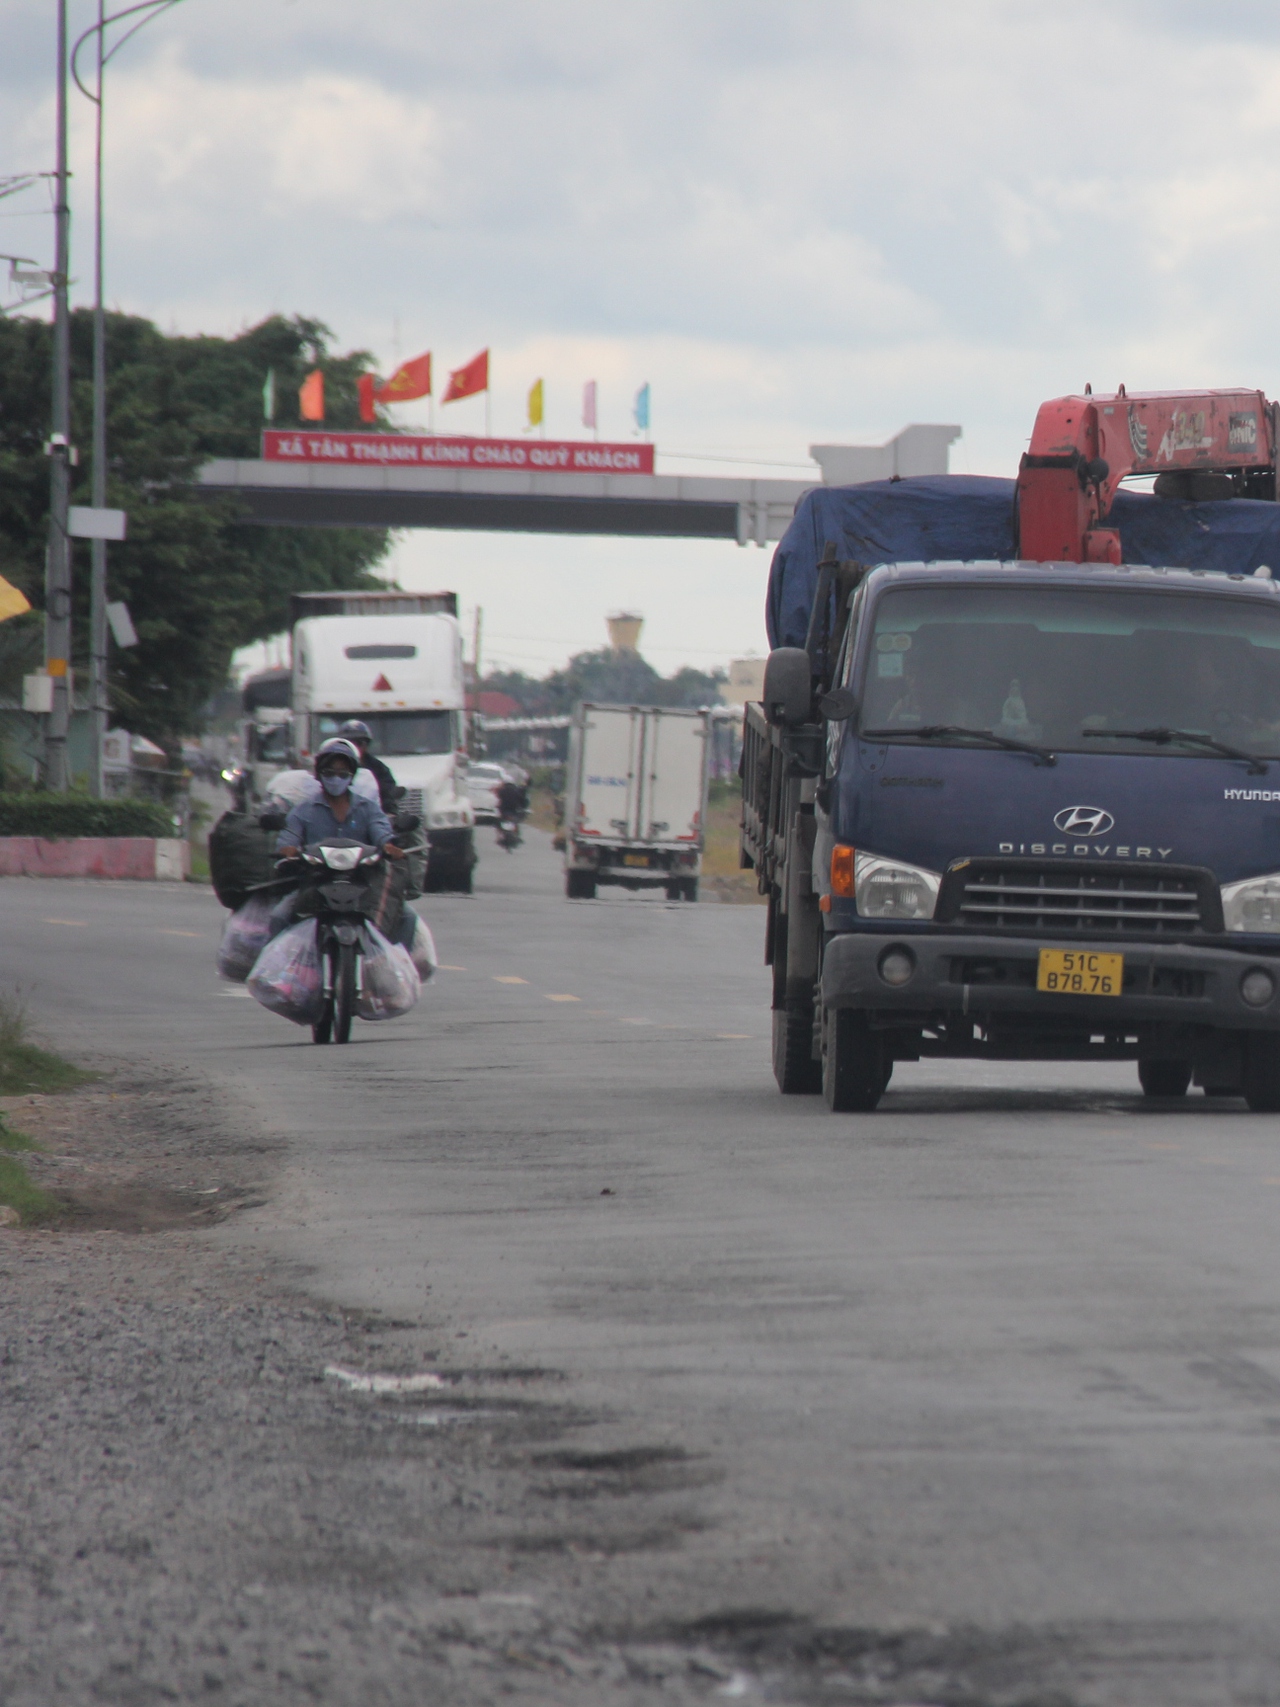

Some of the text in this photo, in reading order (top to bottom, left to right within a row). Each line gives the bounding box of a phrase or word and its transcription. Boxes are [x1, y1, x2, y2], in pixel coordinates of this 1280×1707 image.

[278, 435, 305, 456] XÃ
[308, 436, 347, 458] TÂN
[351, 442, 418, 464] THẠNH
[421, 441, 470, 462] KÍNH
[472, 443, 527, 465] CHÀO
[573, 446, 640, 469] KHÁCH
[998, 842, 1172, 859] DISCOVERY
[1063, 953, 1098, 972] 51C
[1046, 972, 1112, 993] 878.76
